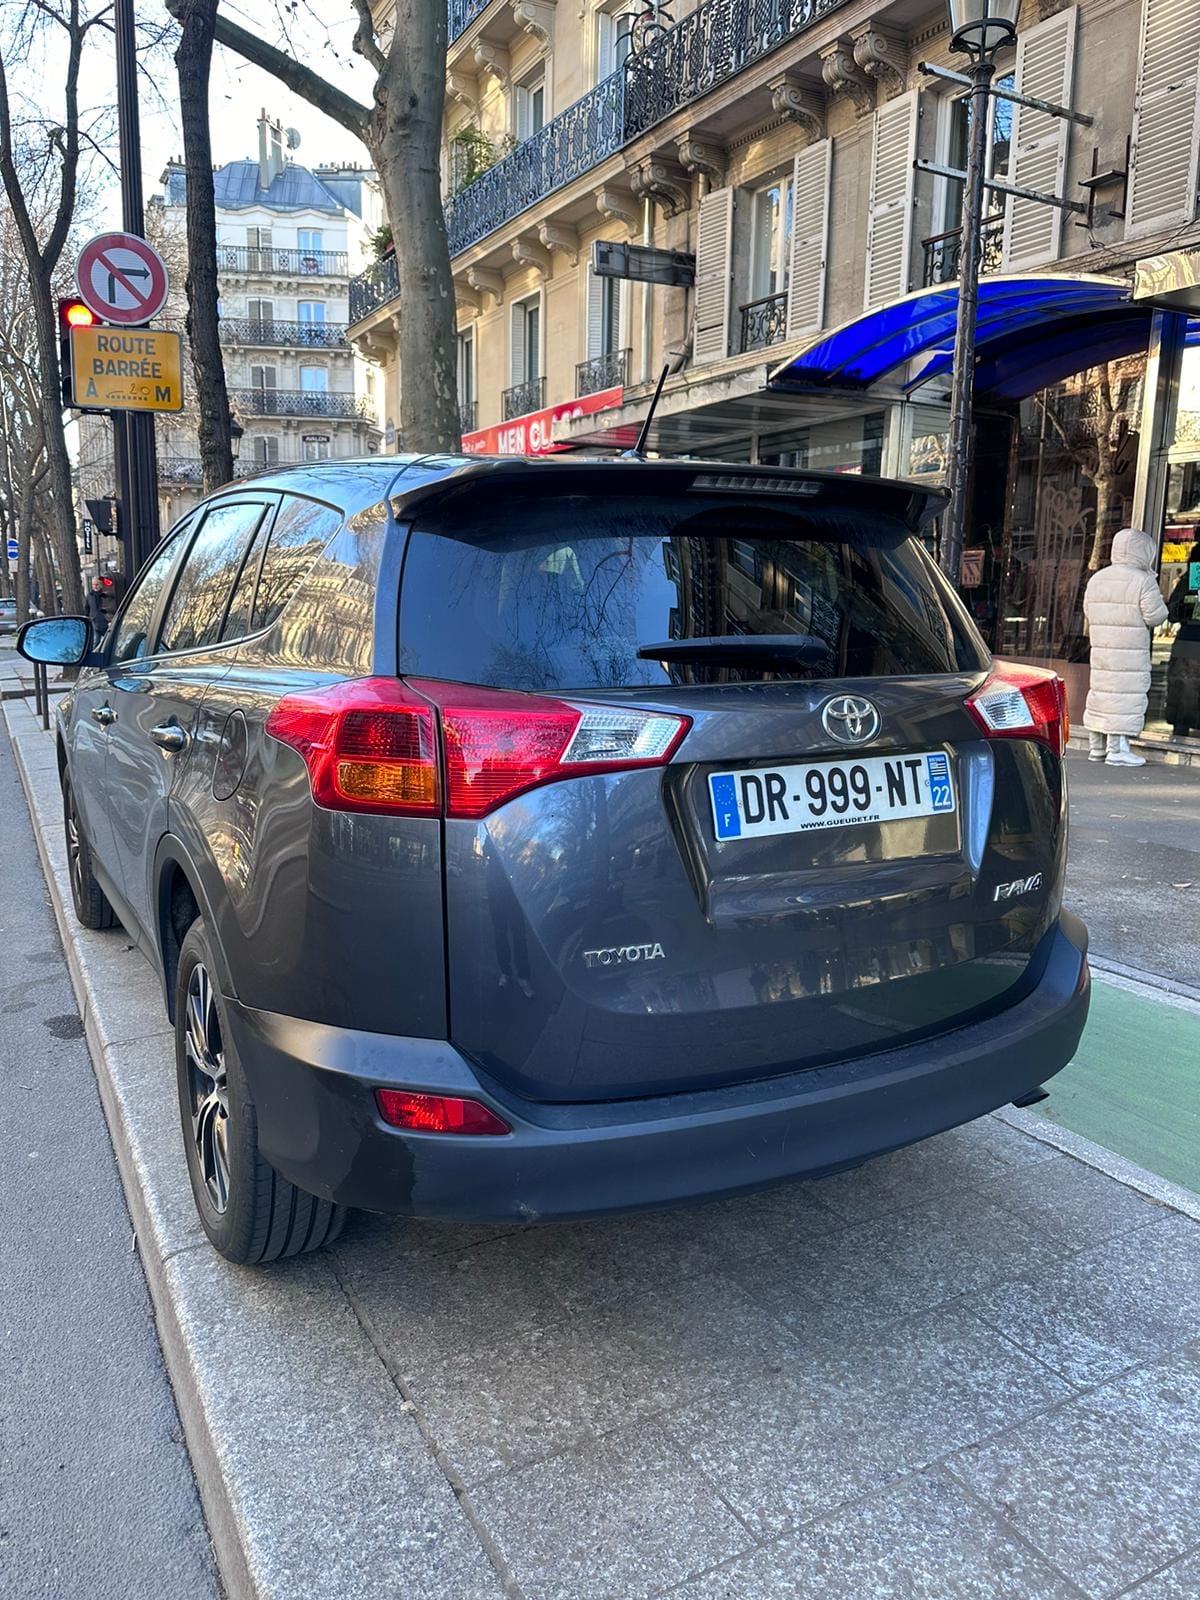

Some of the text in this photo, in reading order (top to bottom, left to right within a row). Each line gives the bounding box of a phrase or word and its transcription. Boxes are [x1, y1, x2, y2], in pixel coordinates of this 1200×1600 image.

[97, 335, 156, 355] ROUTE
[93, 358, 162, 379] BARRÉE
[86, 377, 98, 398] À
[155, 385, 171, 402] M
[498, 424, 526, 454] MEN
[740, 759, 922, 824] DR-999-NT
[933, 785, 951, 806] 22
[724, 813, 732, 828] F
[800, 815, 880, 829] WWW.GUEUDET.FR
[584, 943, 666, 968] TOYOTA
